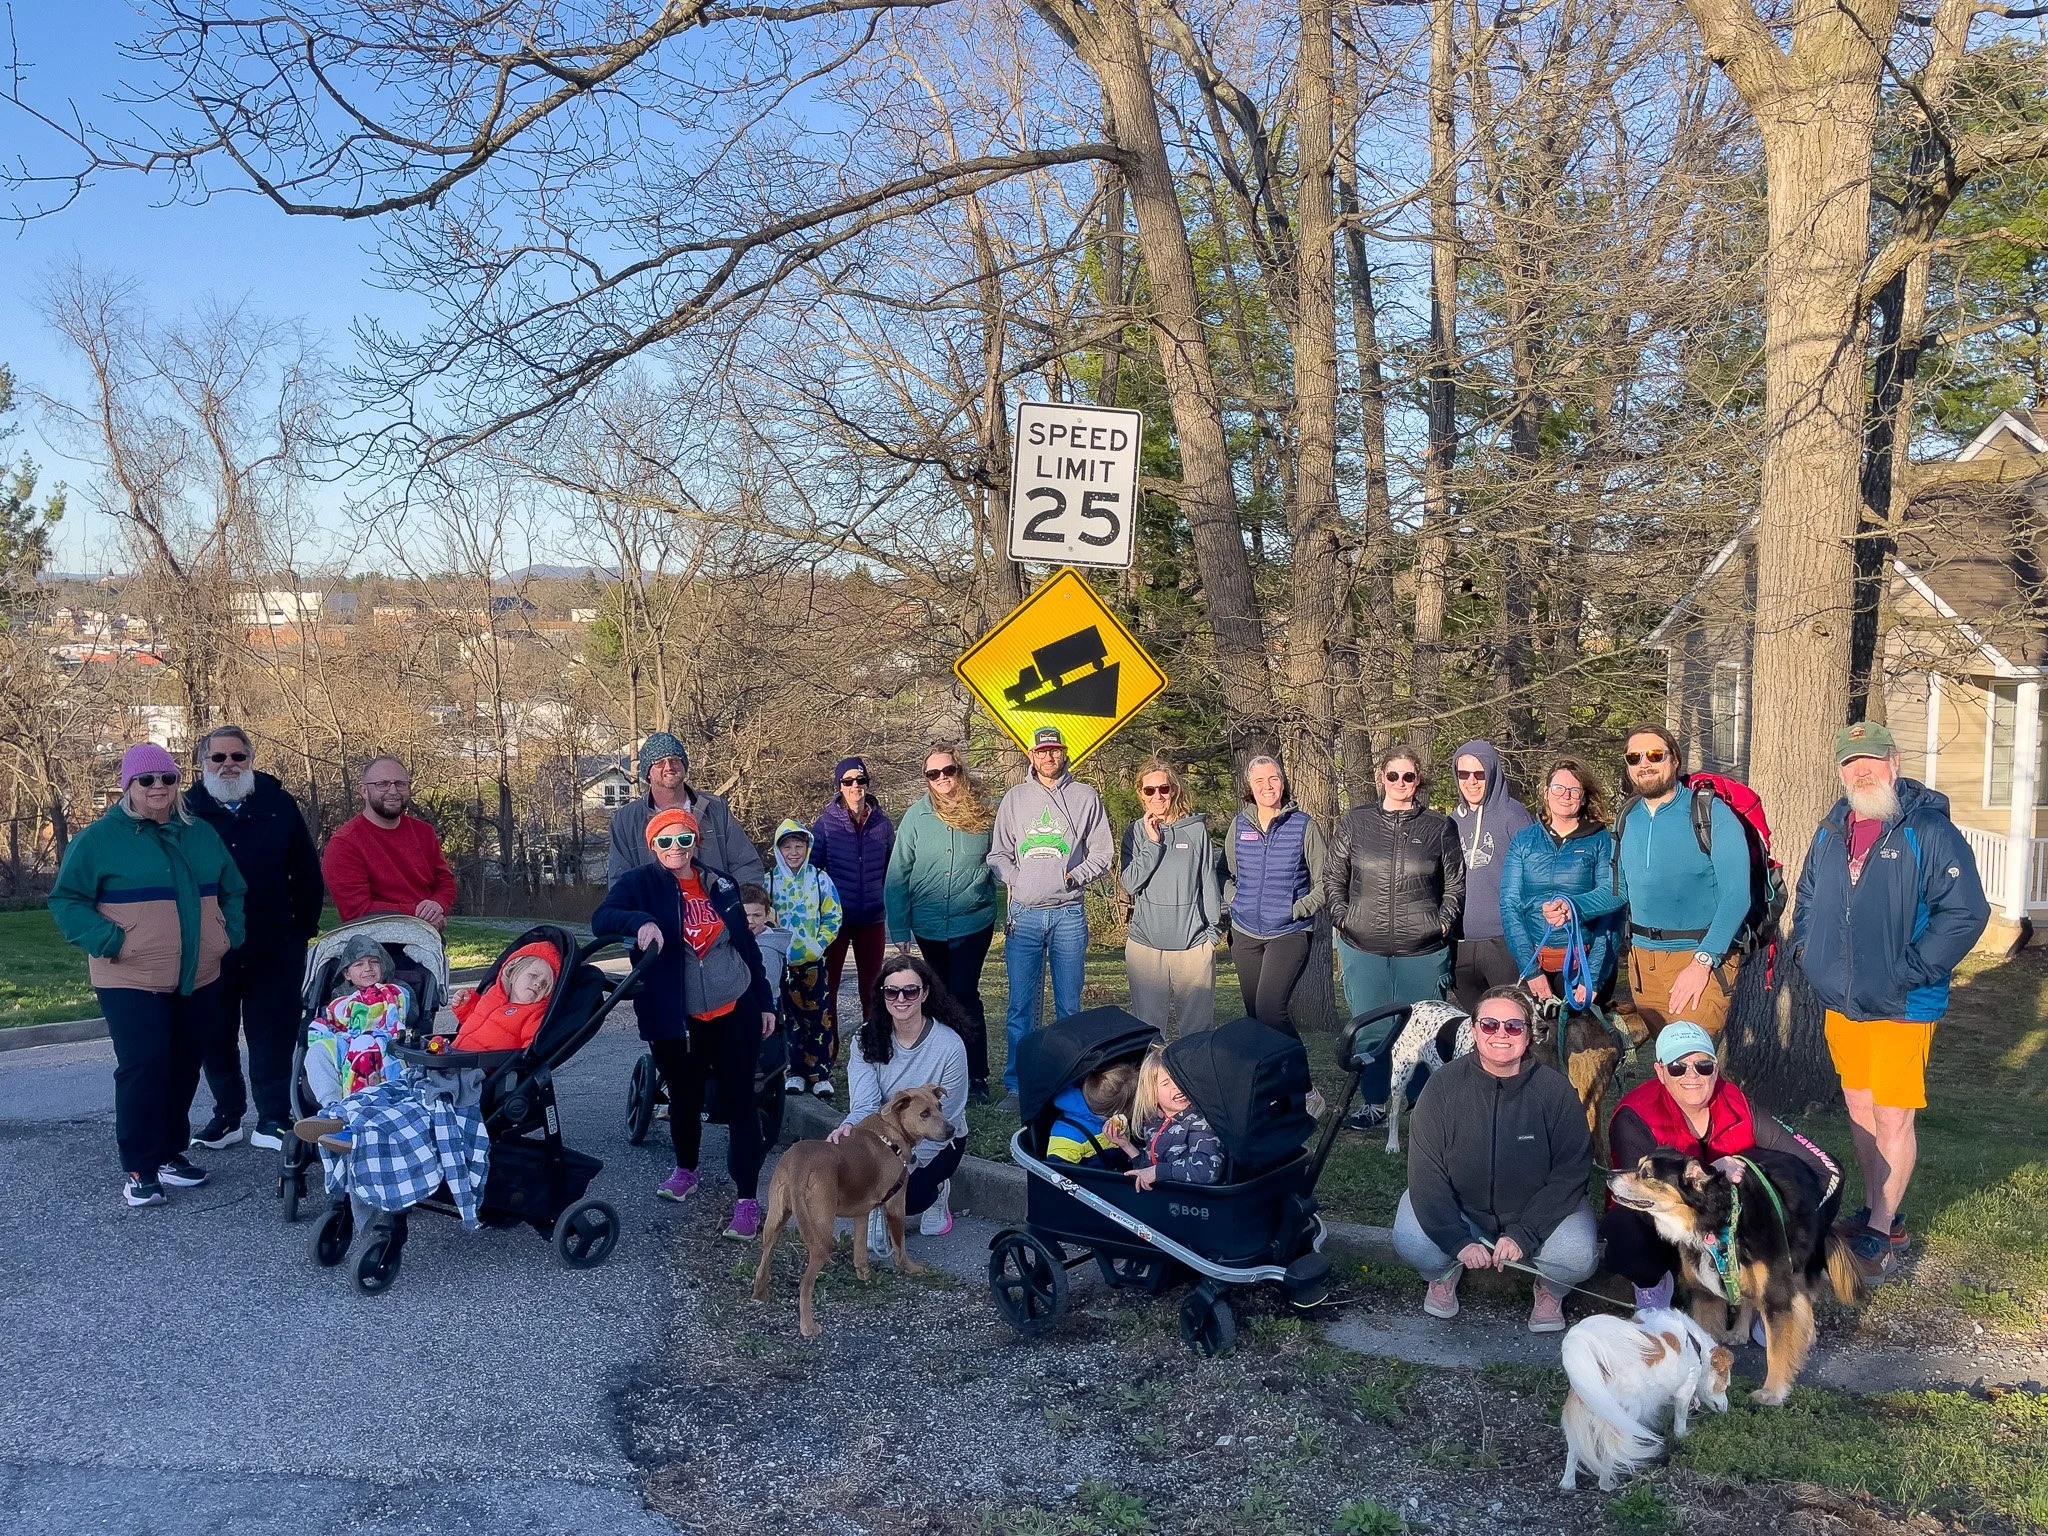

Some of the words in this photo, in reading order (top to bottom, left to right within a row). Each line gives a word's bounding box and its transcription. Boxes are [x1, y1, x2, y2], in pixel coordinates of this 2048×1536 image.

[1028, 422, 1128, 451] SPEED
[1036, 455, 1115, 483] LIMIT
[1022, 486, 1121, 547] 25
[546, 1105, 558, 1134] MODES
